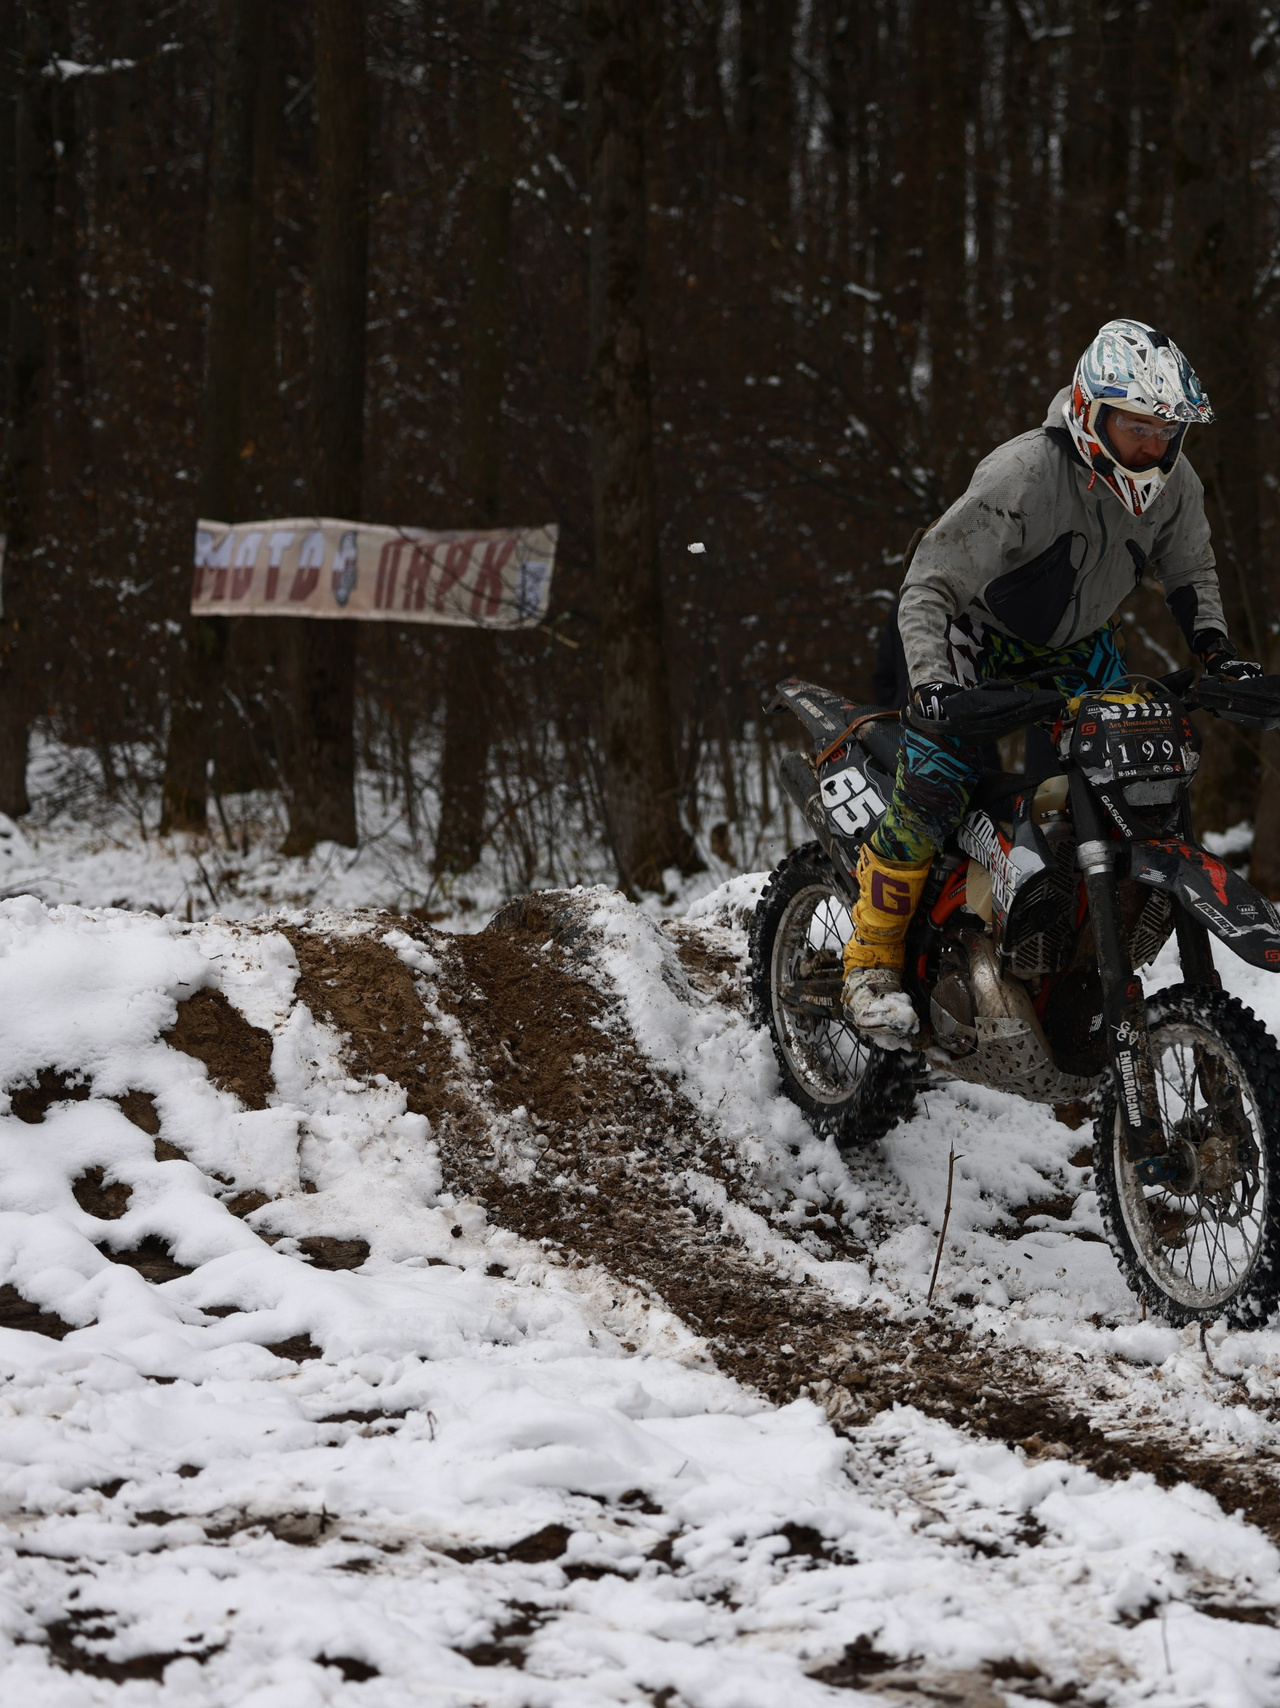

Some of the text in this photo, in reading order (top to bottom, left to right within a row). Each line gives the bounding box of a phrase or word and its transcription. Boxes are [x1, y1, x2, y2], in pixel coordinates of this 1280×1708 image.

[373, 536, 516, 617] ПАРК
[1118, 740, 1174, 764] 199
[820, 766, 887, 835] 65
[1100, 795, 1133, 838] GASGAS
[871, 869, 911, 916] G
[1118, 1050, 1142, 1128] ENDUROCAMP
